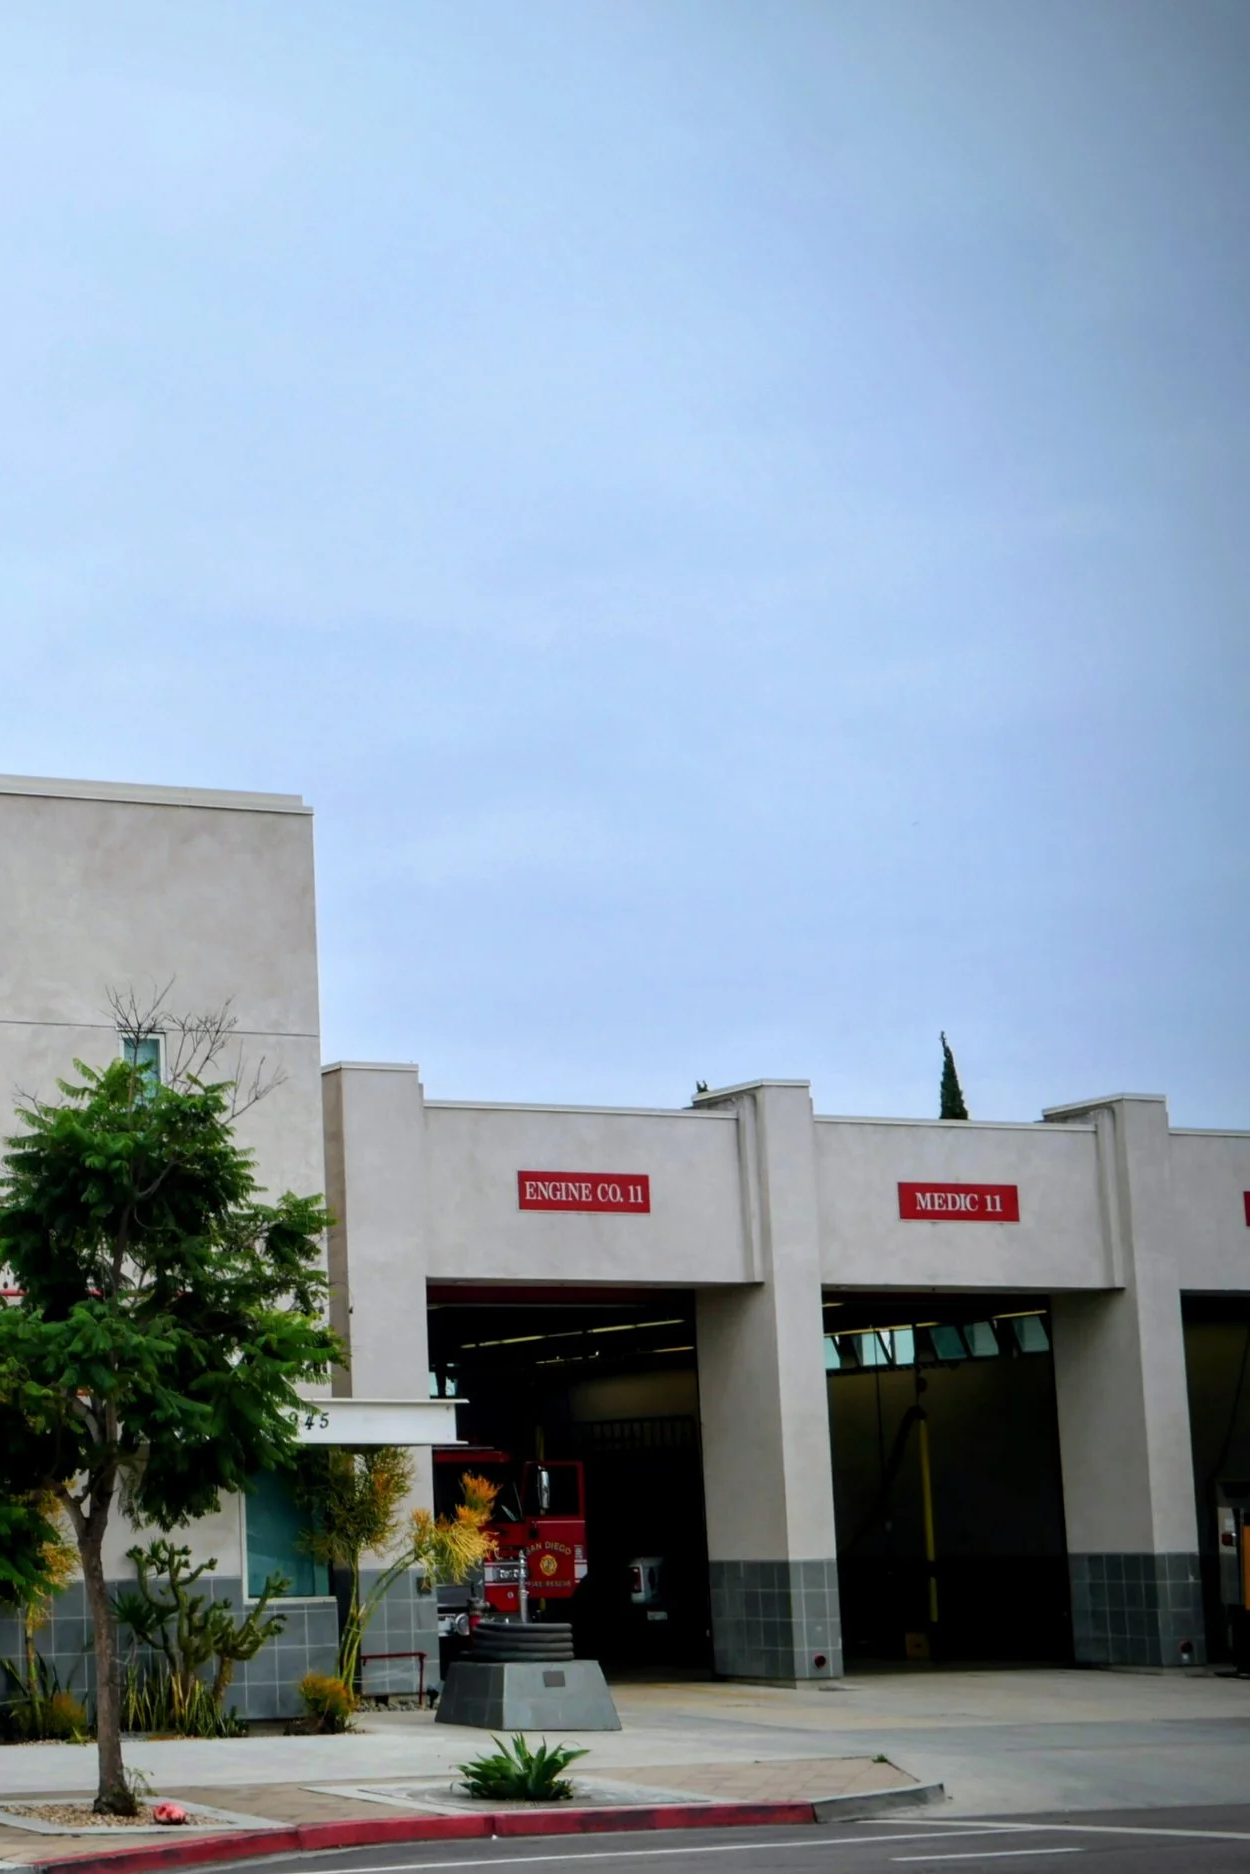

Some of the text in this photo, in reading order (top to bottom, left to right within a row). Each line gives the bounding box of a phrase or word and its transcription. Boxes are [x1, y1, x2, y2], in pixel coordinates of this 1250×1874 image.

[524, 1181, 644, 1203] ENGINE CO. 11
[915, 1192, 1003, 1213] MEDIC 11
[526, 1542, 542, 1555] SAN
[544, 1541, 572, 1555] DIEGO
